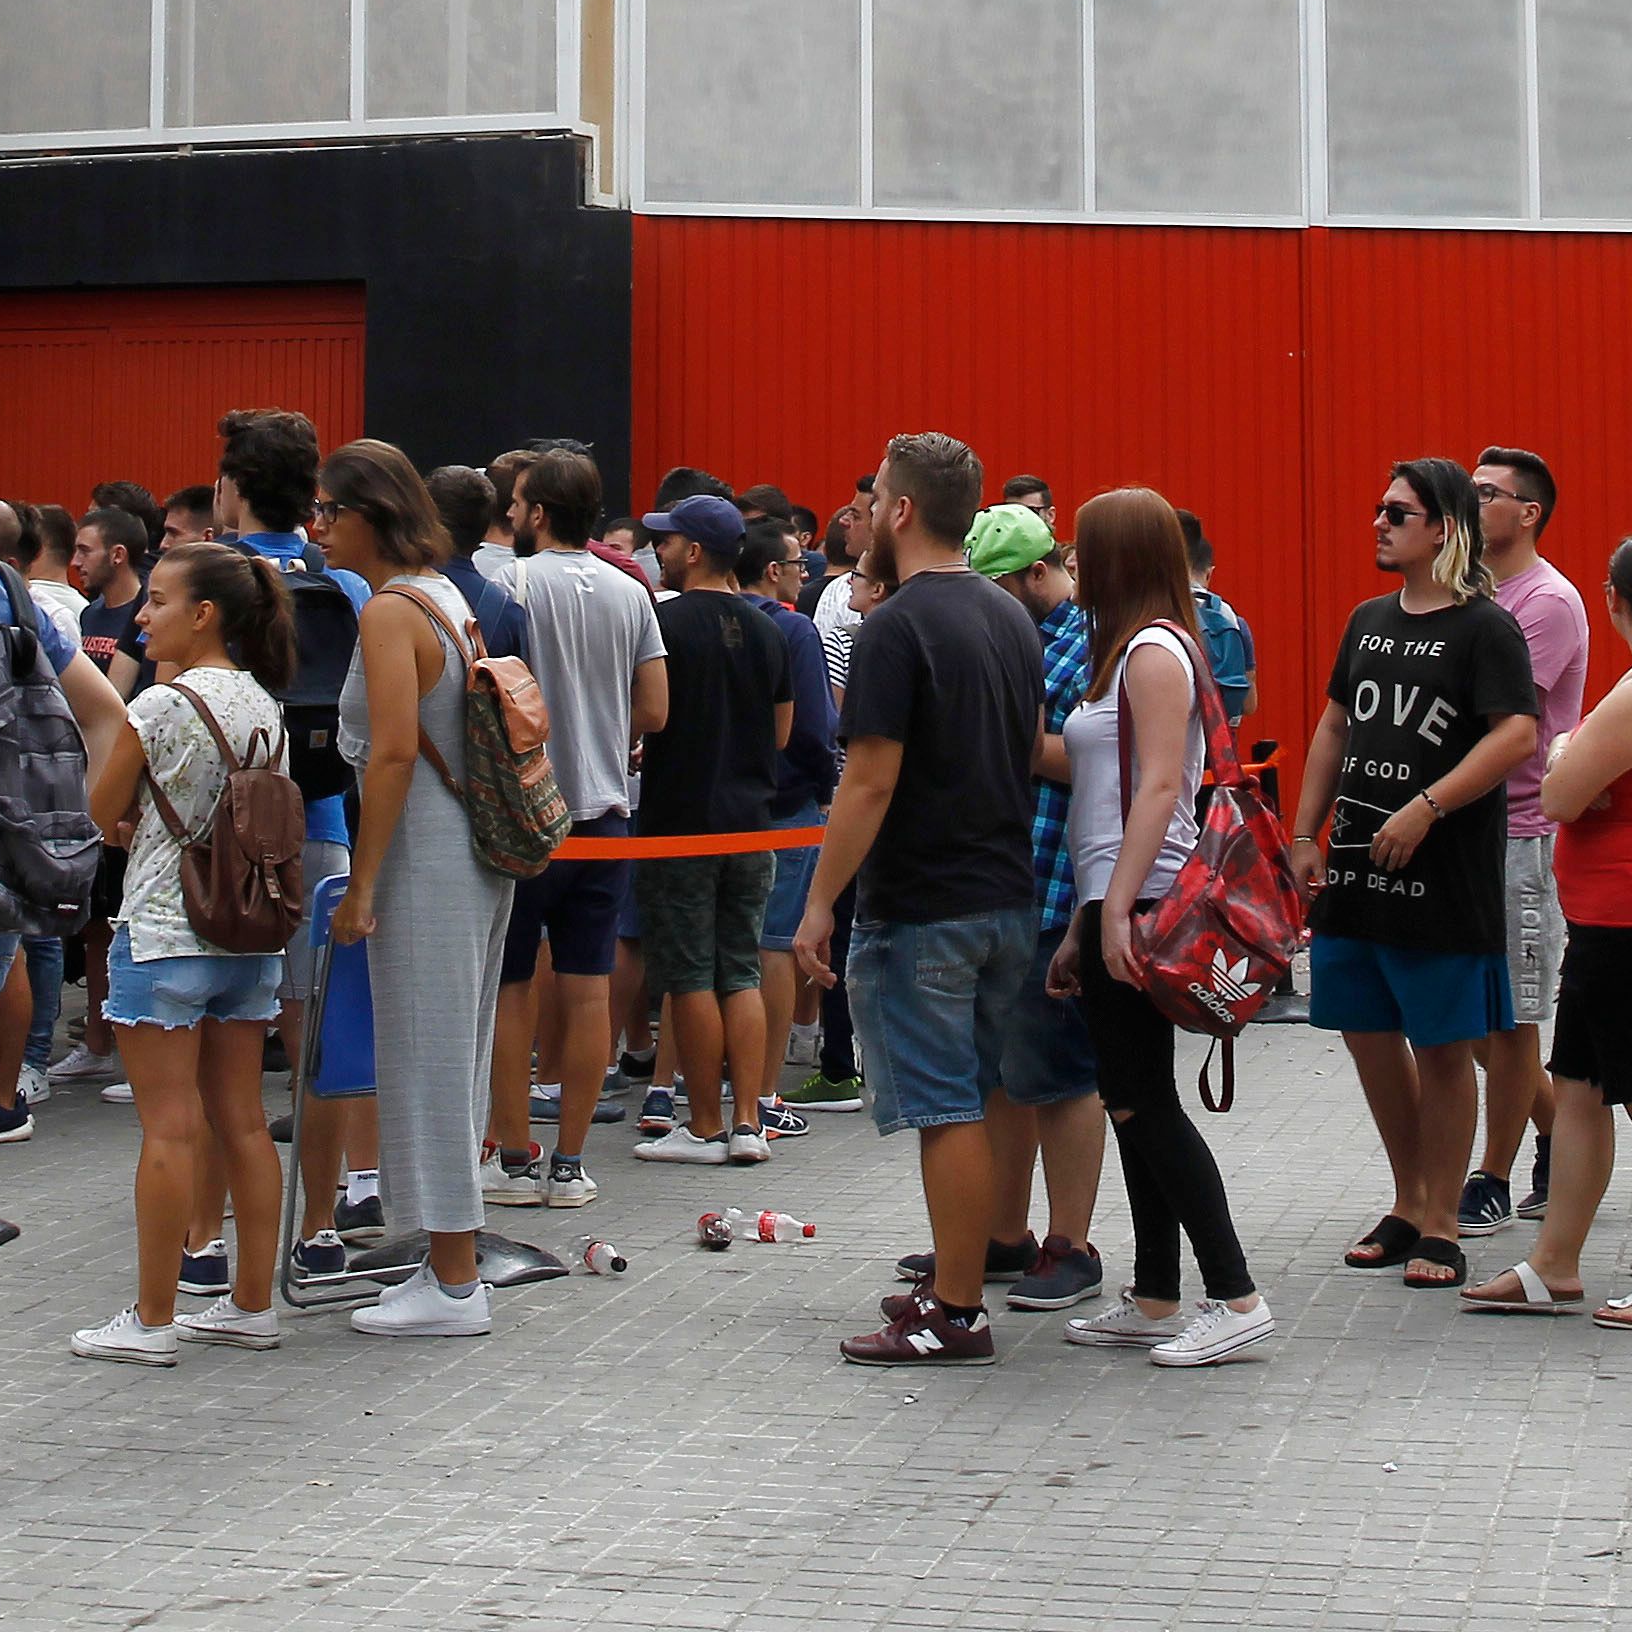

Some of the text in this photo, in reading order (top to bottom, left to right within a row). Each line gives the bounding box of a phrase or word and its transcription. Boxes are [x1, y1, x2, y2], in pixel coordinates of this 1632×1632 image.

[1358, 634, 1446, 657] FOR THE
[1346, 679, 1458, 746] OVE
[1364, 759, 1411, 780] GOD
[1367, 873, 1425, 897] DEAD
[1188, 982, 1236, 1023] adidas
